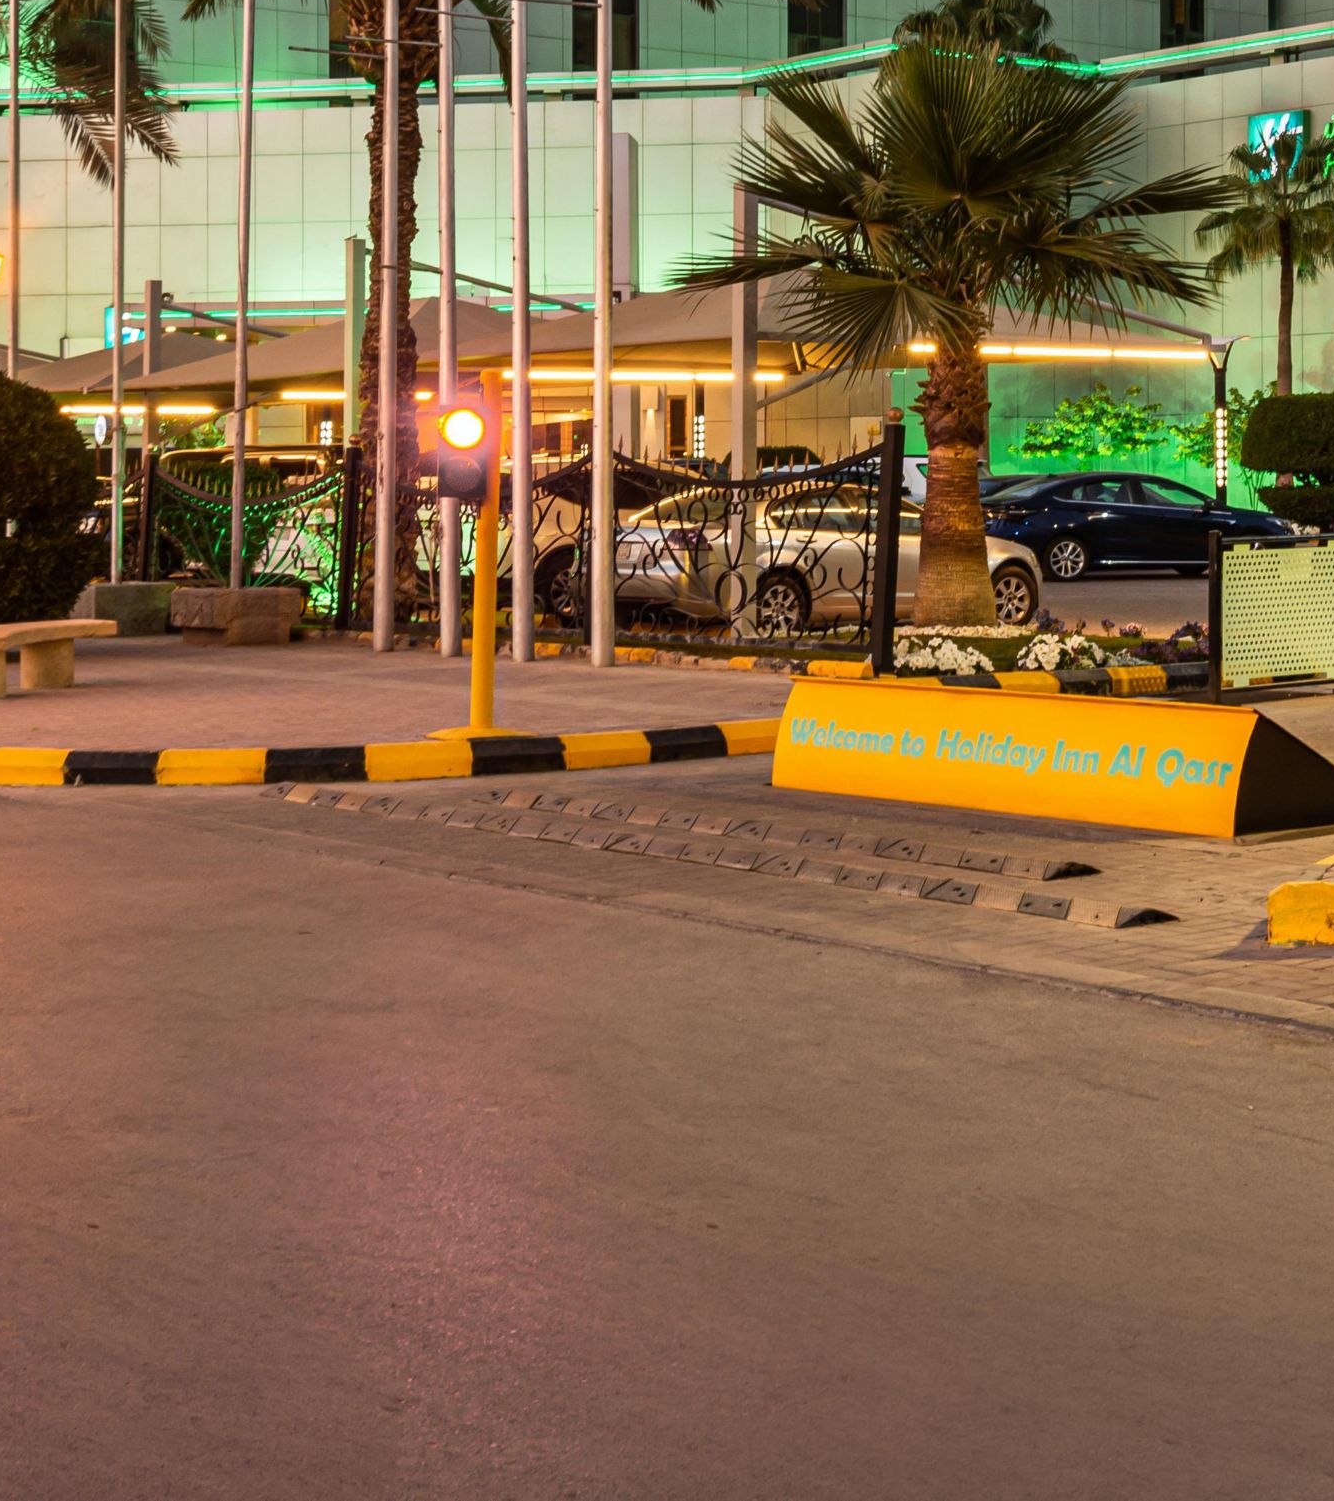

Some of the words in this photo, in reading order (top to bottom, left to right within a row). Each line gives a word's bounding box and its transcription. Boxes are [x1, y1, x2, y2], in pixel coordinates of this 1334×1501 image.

[790, 717, 895, 755] Welcome
[900, 729, 925, 758] to
[935, 728, 1045, 775] Holiday
[1052, 739, 1100, 774] Inn
[1108, 743, 1146, 778] Al
[1156, 748, 1234, 788] Qasr
